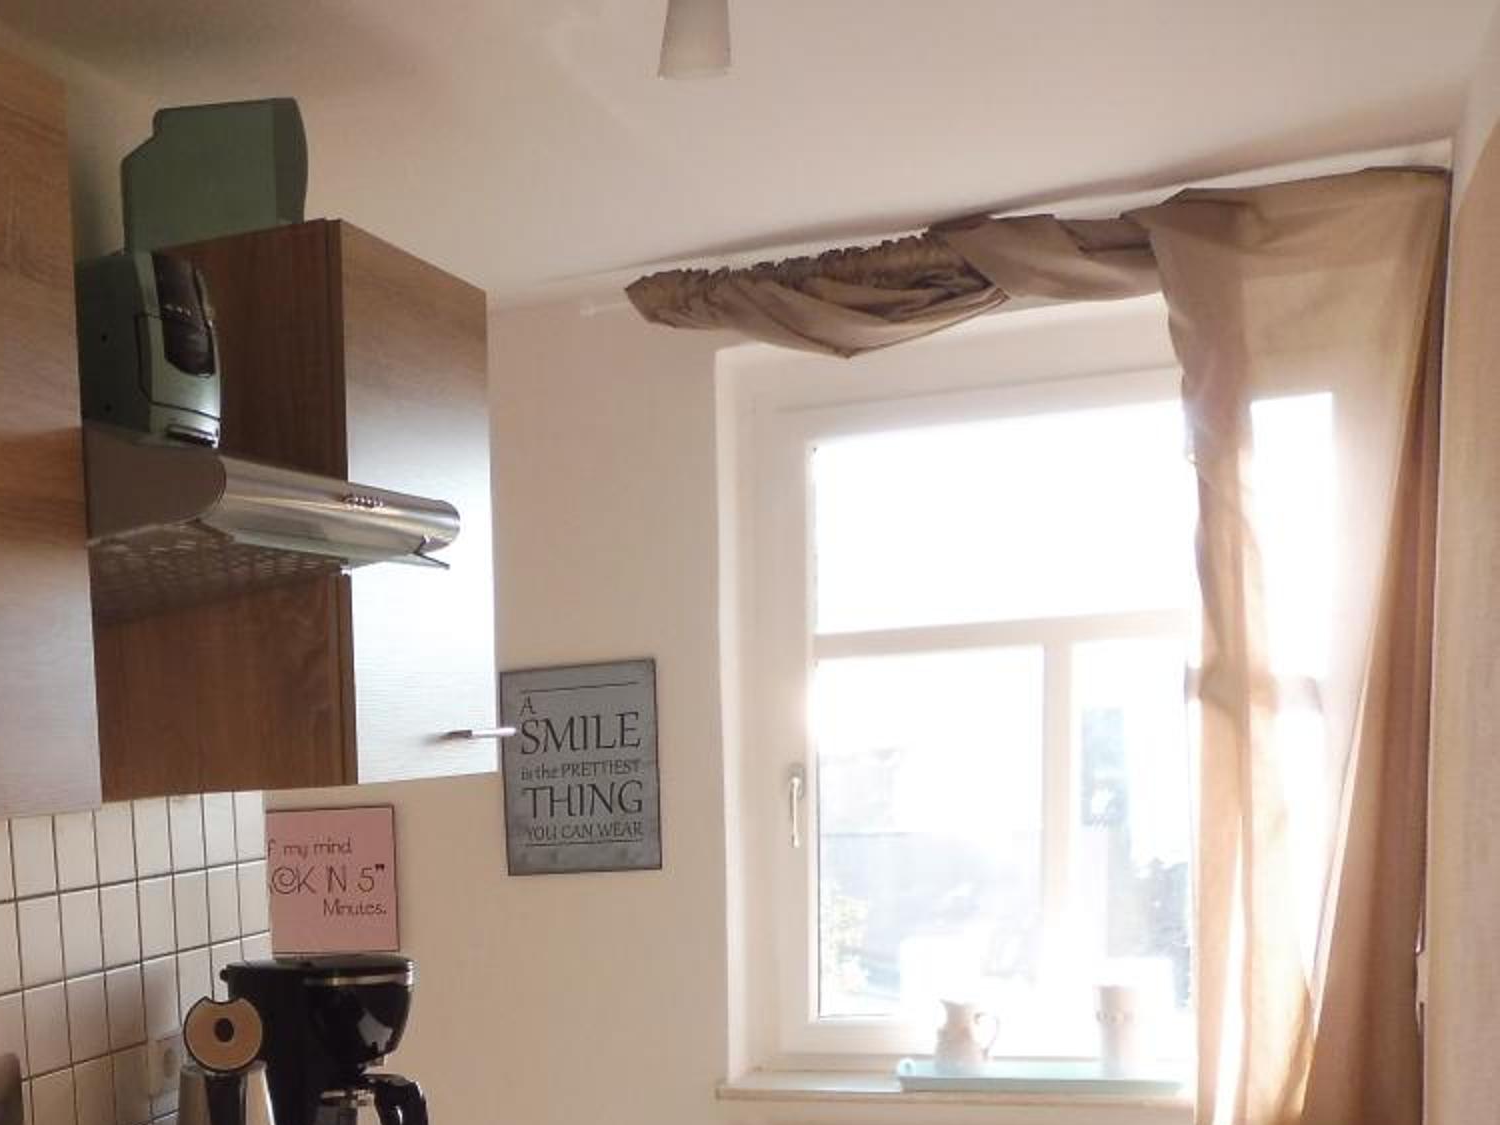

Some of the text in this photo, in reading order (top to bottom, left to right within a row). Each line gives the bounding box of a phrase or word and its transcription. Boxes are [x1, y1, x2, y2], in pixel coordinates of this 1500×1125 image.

[520, 696, 536, 716] A
[520, 712, 642, 755] SMILE
[535, 763, 557, 780] the
[561, 759, 641, 778] PRETTIEST
[522, 780, 643, 819] THING
[528, 821, 644, 841] YOU CAN WEAR
[283, 845, 308, 858] my
